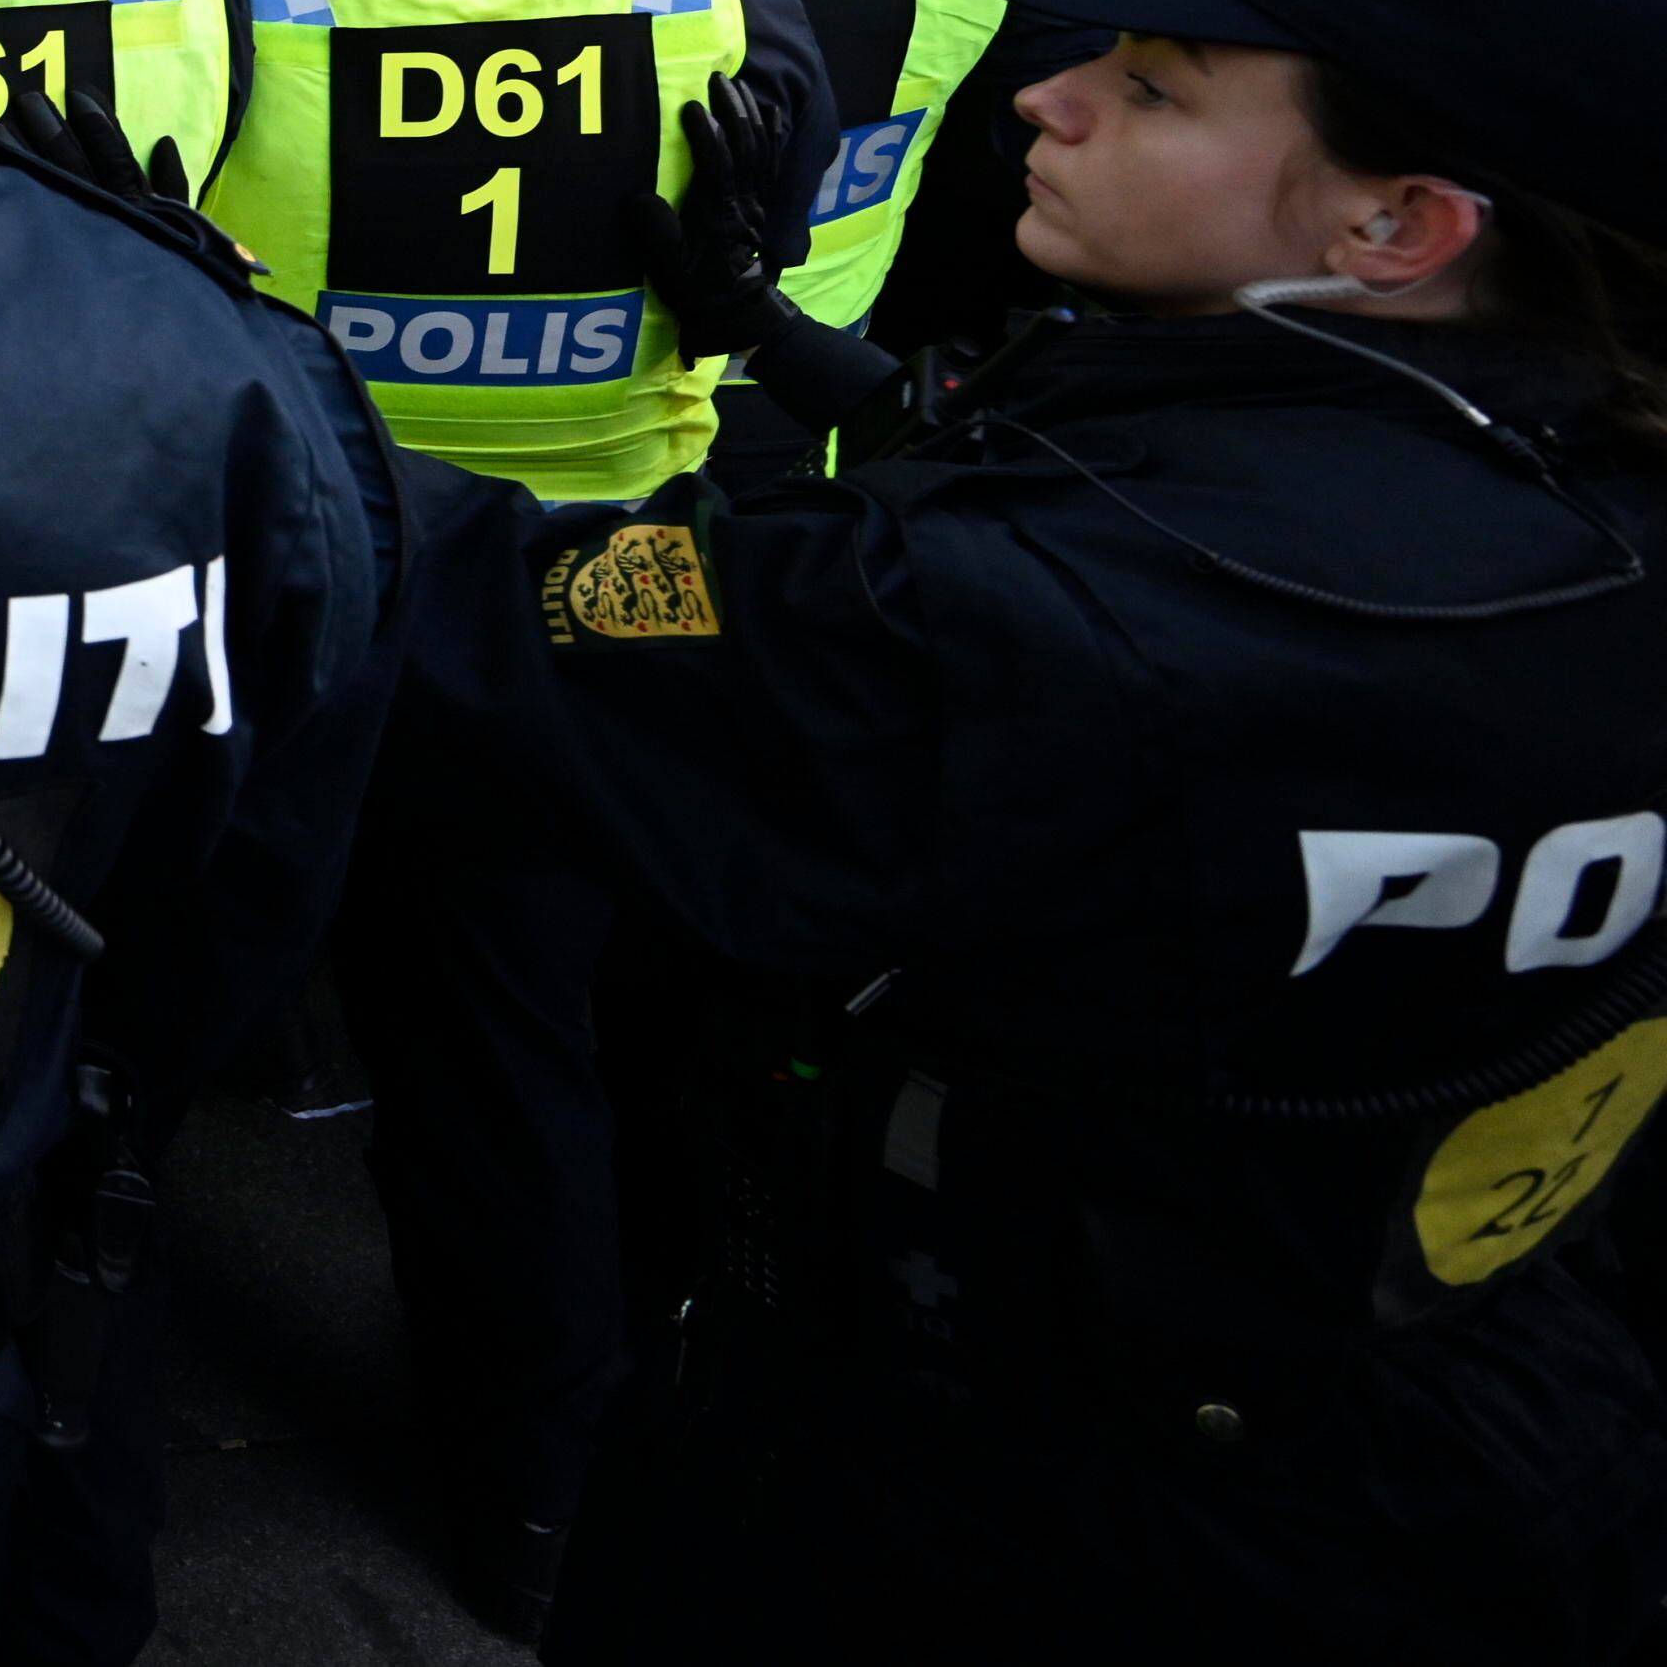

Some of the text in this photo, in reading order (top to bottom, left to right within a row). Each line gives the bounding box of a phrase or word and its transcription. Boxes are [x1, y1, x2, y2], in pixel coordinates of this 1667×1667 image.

[379, 45, 603, 138] D61
[459, 167, 522, 275] 1
[325, 306, 629, 375] POLIS
[541, 548, 581, 644] POLITI
[1288, 810, 1666, 977] PO
[1584, 1073, 1625, 1144] 1
[1470, 1152, 1589, 1242] 22
